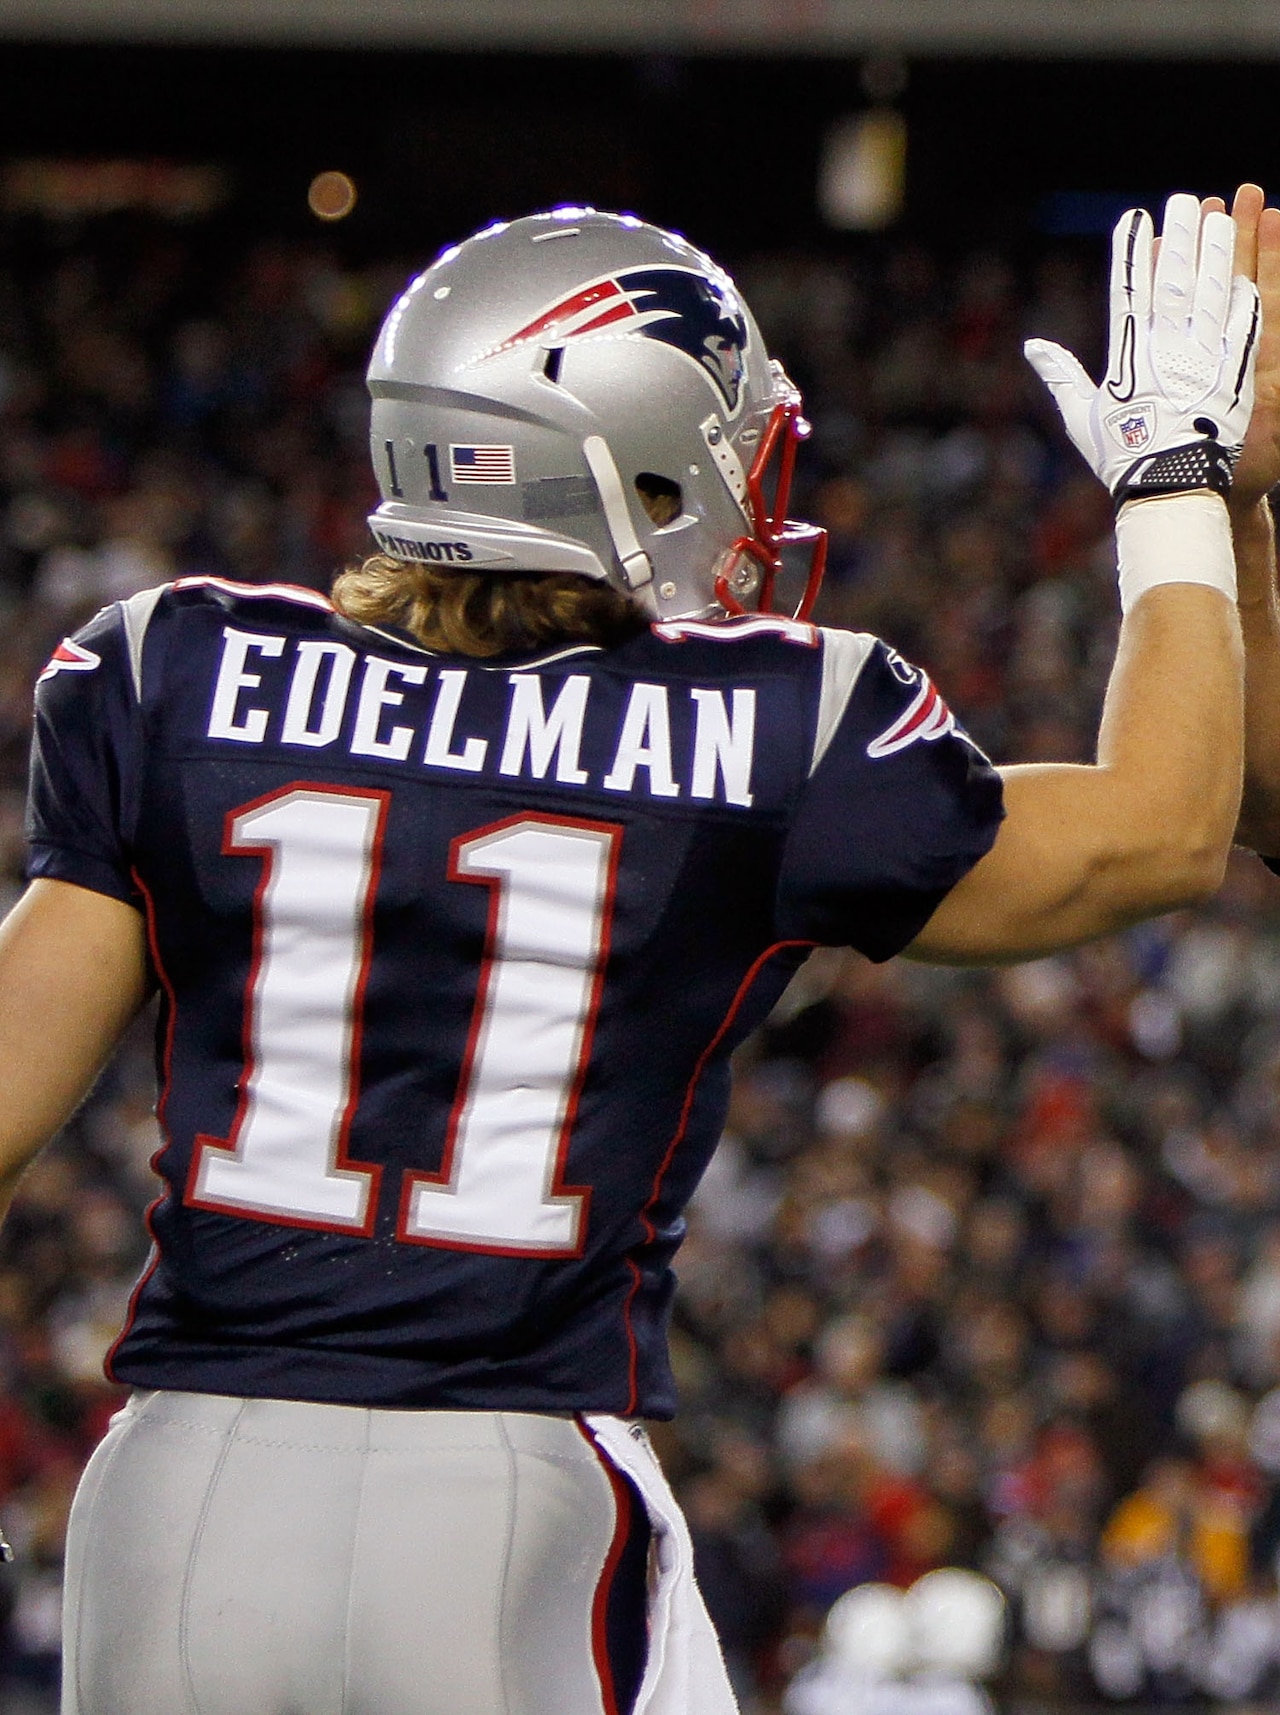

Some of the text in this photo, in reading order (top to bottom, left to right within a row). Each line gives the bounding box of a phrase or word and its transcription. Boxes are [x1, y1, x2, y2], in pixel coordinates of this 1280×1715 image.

[1124, 428, 1147, 446] NFL
[384, 440, 448, 502] 11
[376, 531, 474, 562] PATRIOTS
[207, 626, 756, 808] EDELMAN
[185, 780, 624, 1259] 11
